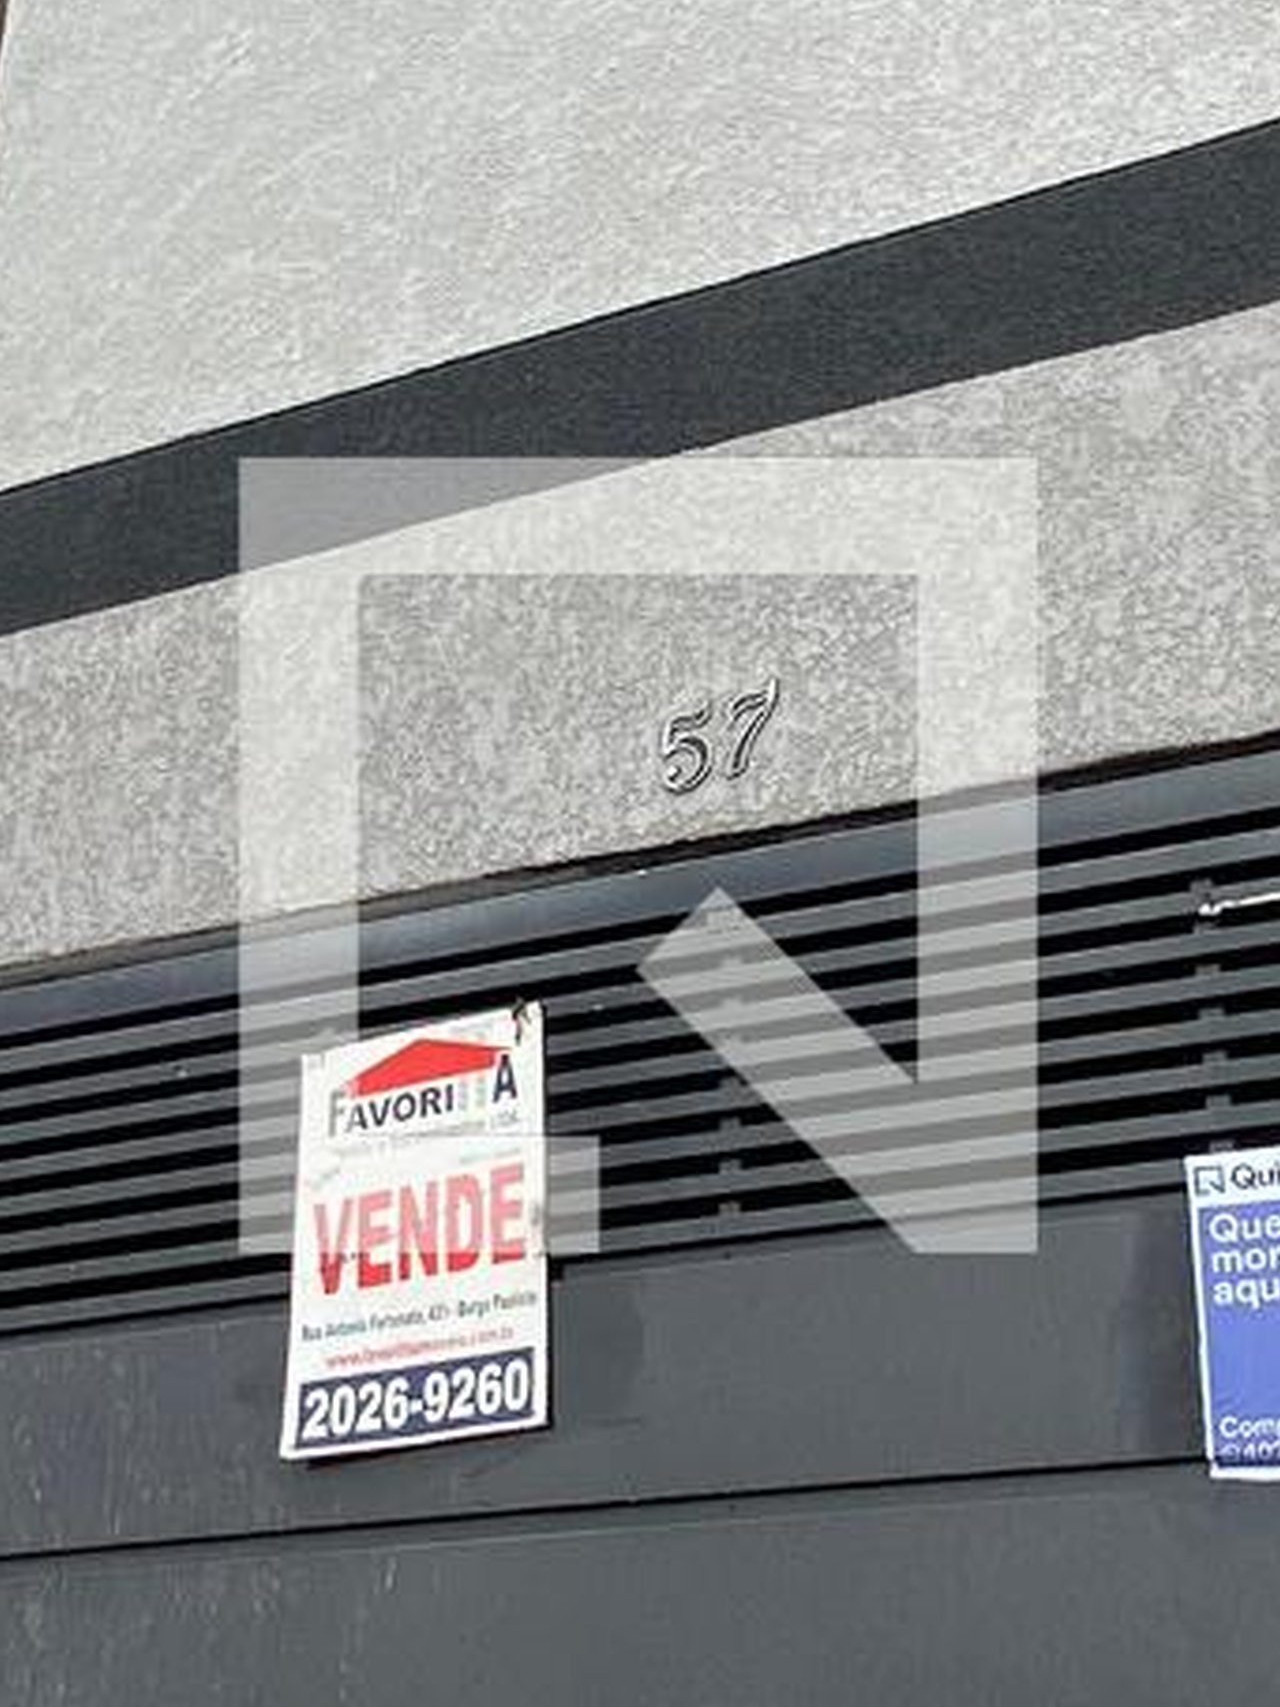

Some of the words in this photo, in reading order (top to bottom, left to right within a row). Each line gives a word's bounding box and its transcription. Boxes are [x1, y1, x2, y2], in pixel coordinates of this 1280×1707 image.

[660, 678, 779, 795] 57
[313, 1163, 527, 1296] VENDE
[300, 1359, 529, 1440] 2026-9260
